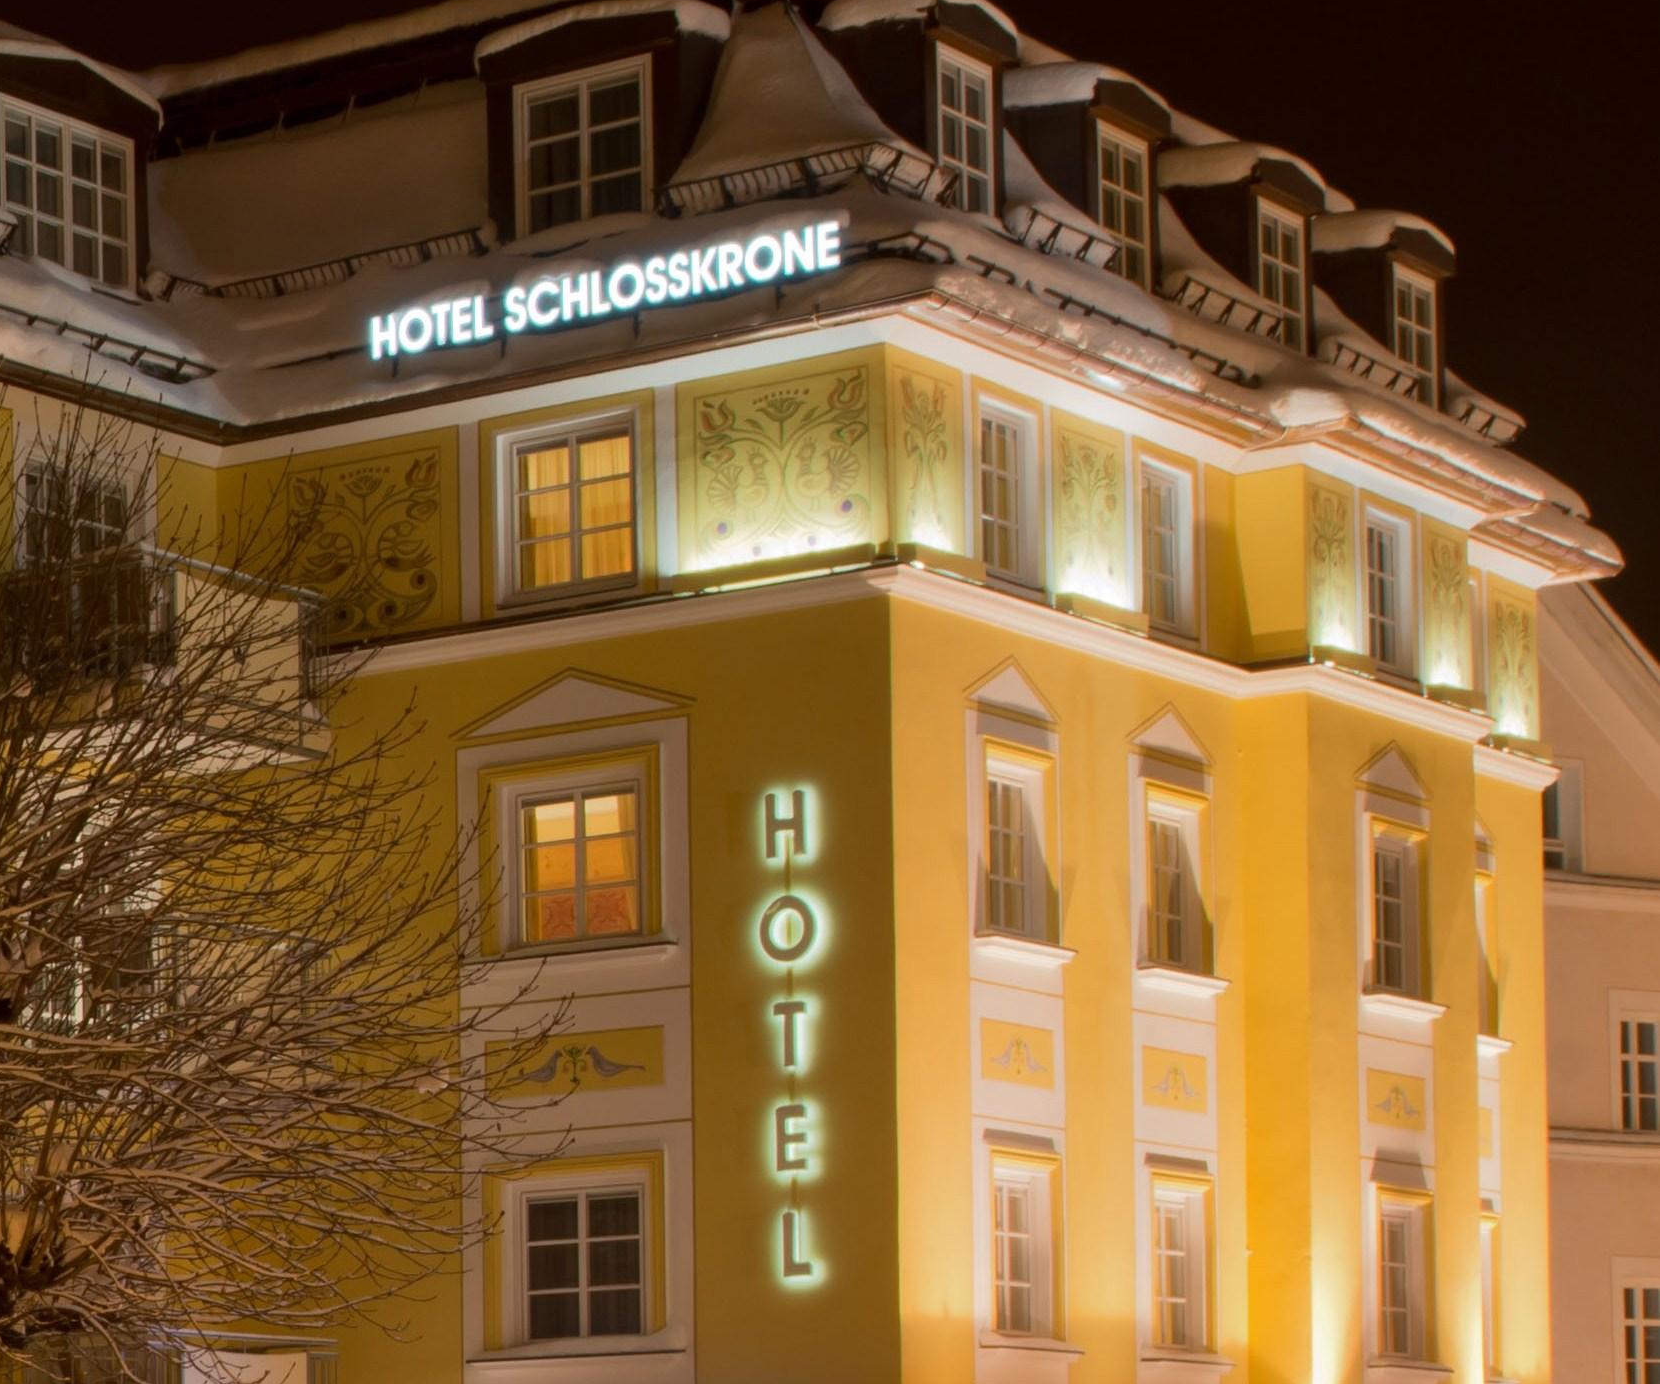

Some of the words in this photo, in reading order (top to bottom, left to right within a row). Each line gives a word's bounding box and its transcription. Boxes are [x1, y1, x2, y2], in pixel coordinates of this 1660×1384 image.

[368, 293, 494, 360] HOTEL
[503, 220, 842, 333] SCHLOSSKRONE
[758, 789, 817, 1278] HOTEL
